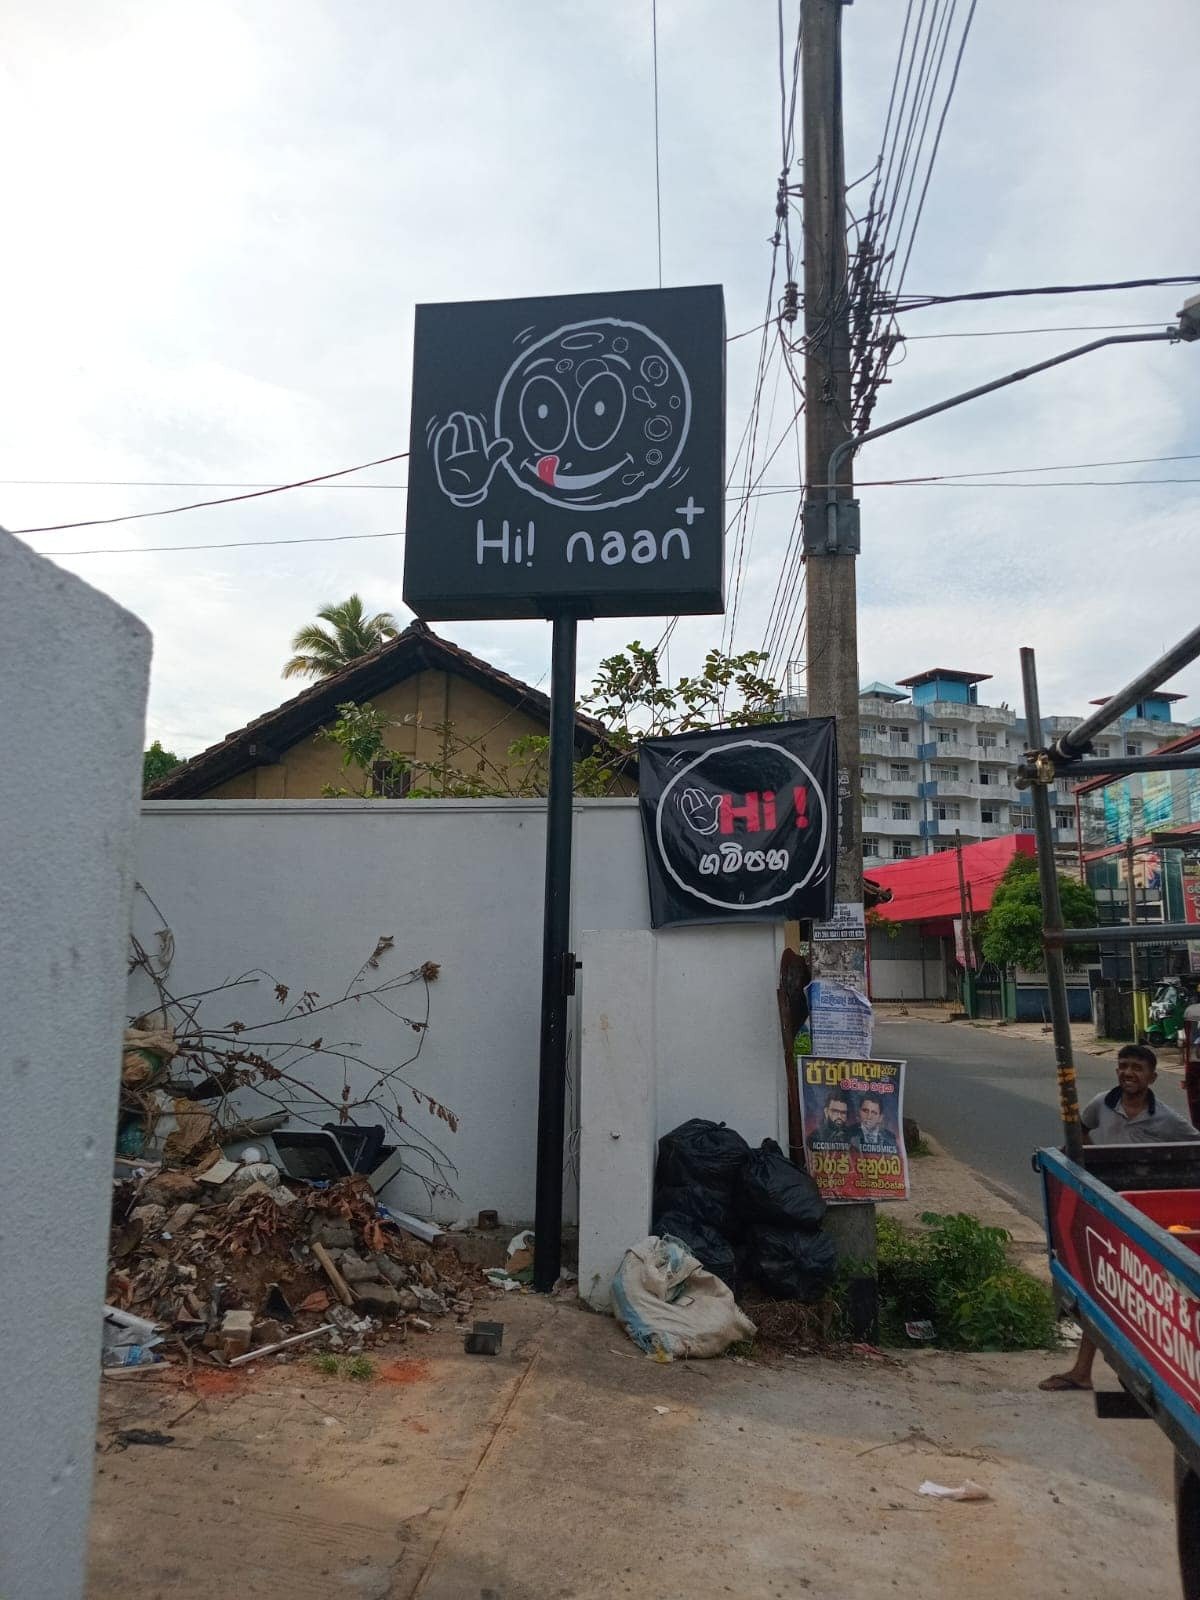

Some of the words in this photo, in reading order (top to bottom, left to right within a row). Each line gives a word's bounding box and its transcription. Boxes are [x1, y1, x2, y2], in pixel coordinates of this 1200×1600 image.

[476, 519, 535, 567] Hi!
[699, 842, 789, 875] ගම්පහ
[860, 1144, 897, 1154] ECONOMICS
[1120, 1243, 1175, 1318] INDOOR
[1179, 1293, 1191, 1333] &
